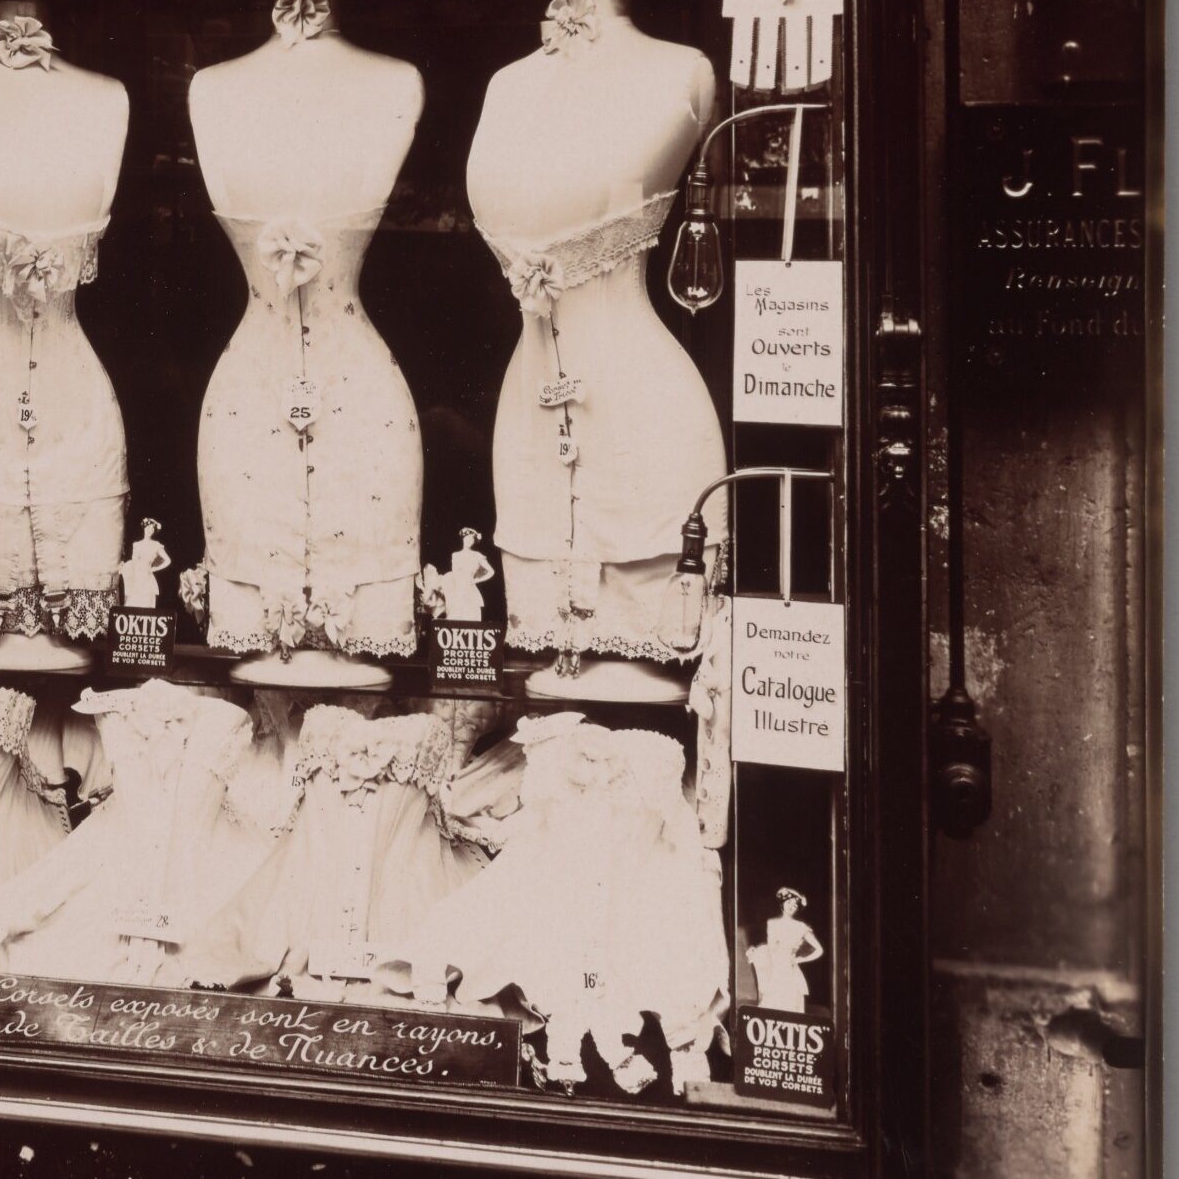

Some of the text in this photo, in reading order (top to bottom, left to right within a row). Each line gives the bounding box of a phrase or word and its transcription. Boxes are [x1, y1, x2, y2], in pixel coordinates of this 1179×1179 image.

[976, 218, 1143, 250] ASSURANCES
[746, 284, 771, 297] Les
[755, 297, 830, 316] Magasins
[778, 327, 809, 337] sont
[751, 338, 831, 357] Ouverts
[744, 373, 835, 398] Dimanche
[290, 406, 311, 419] 25
[746, 622, 831, 645] Demandez
[119, 643, 160, 653] CORSETS
[774, 650, 810, 661] notre
[443, 658, 489, 667] CORSETS
[741, 666, 836, 709] Catalogue
[110, 998, 220, 1021] exposés
[237, 1006, 326, 1031] sont
[332, 1018, 377, 1036] en
[392, 1021, 503, 1055] rayons,
[57, 1013, 176, 1050] Tailles
[191, 1036, 217, 1055] &
[229, 1031, 268, 1060] de
[279, 1033, 449, 1077] Nuances.
[744, 1066, 783, 1080] DOUBLENT
[784, 1073, 794, 1082] LA
[753, 1057, 814, 1075] CORSETS
[744, 1075, 756, 1084] DE
[758, 1078, 778, 1088] VOS
